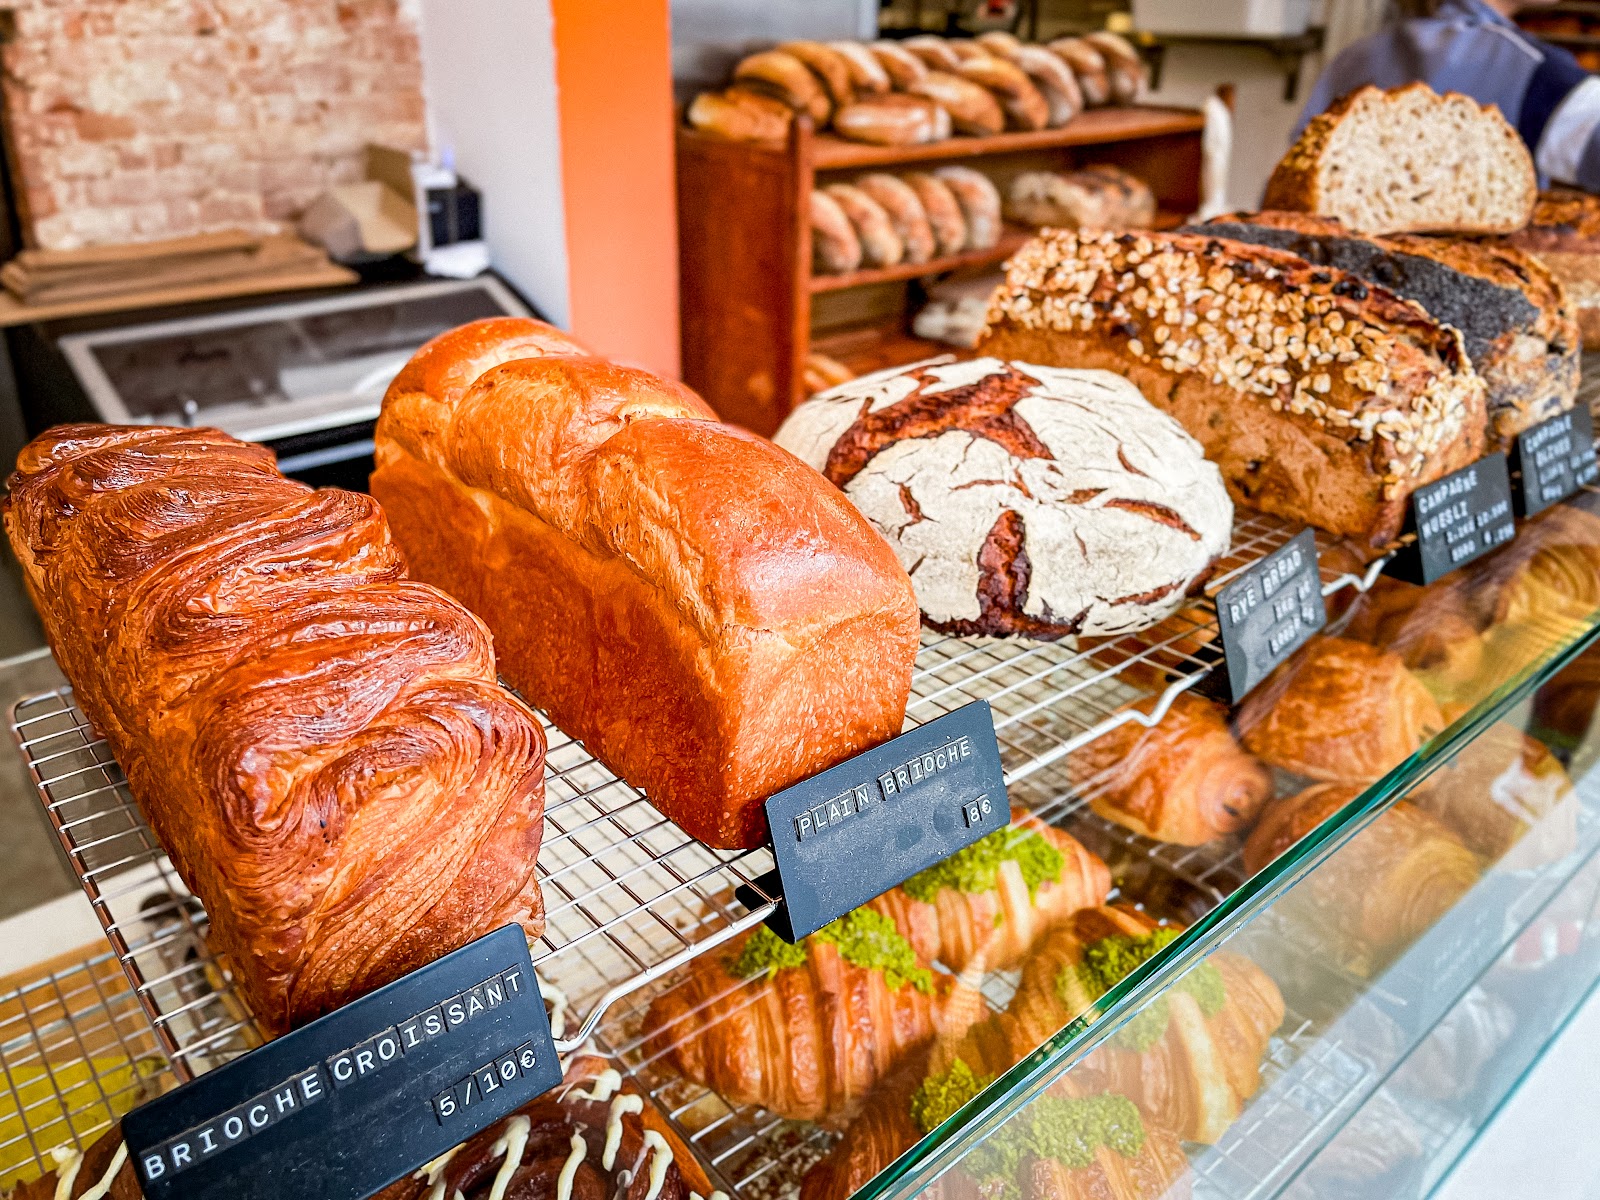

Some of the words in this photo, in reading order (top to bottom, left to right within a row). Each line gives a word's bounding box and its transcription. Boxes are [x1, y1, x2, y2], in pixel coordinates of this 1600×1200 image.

[1419, 470, 1477, 514] CAMPAGNE
[1422, 501, 1468, 539] MUESLI
[1231, 588, 1256, 624] RYE
[1263, 551, 1301, 599] BREAD
[800, 788, 869, 835] PLAIN
[884, 740, 971, 795] BRIOCHE
[969, 800, 992, 823] 8€
[144, 1073, 323, 1181] BRIOCHE
[333, 972, 520, 1083] CROISSANT
[438, 1049, 538, 1117] 5/10€
